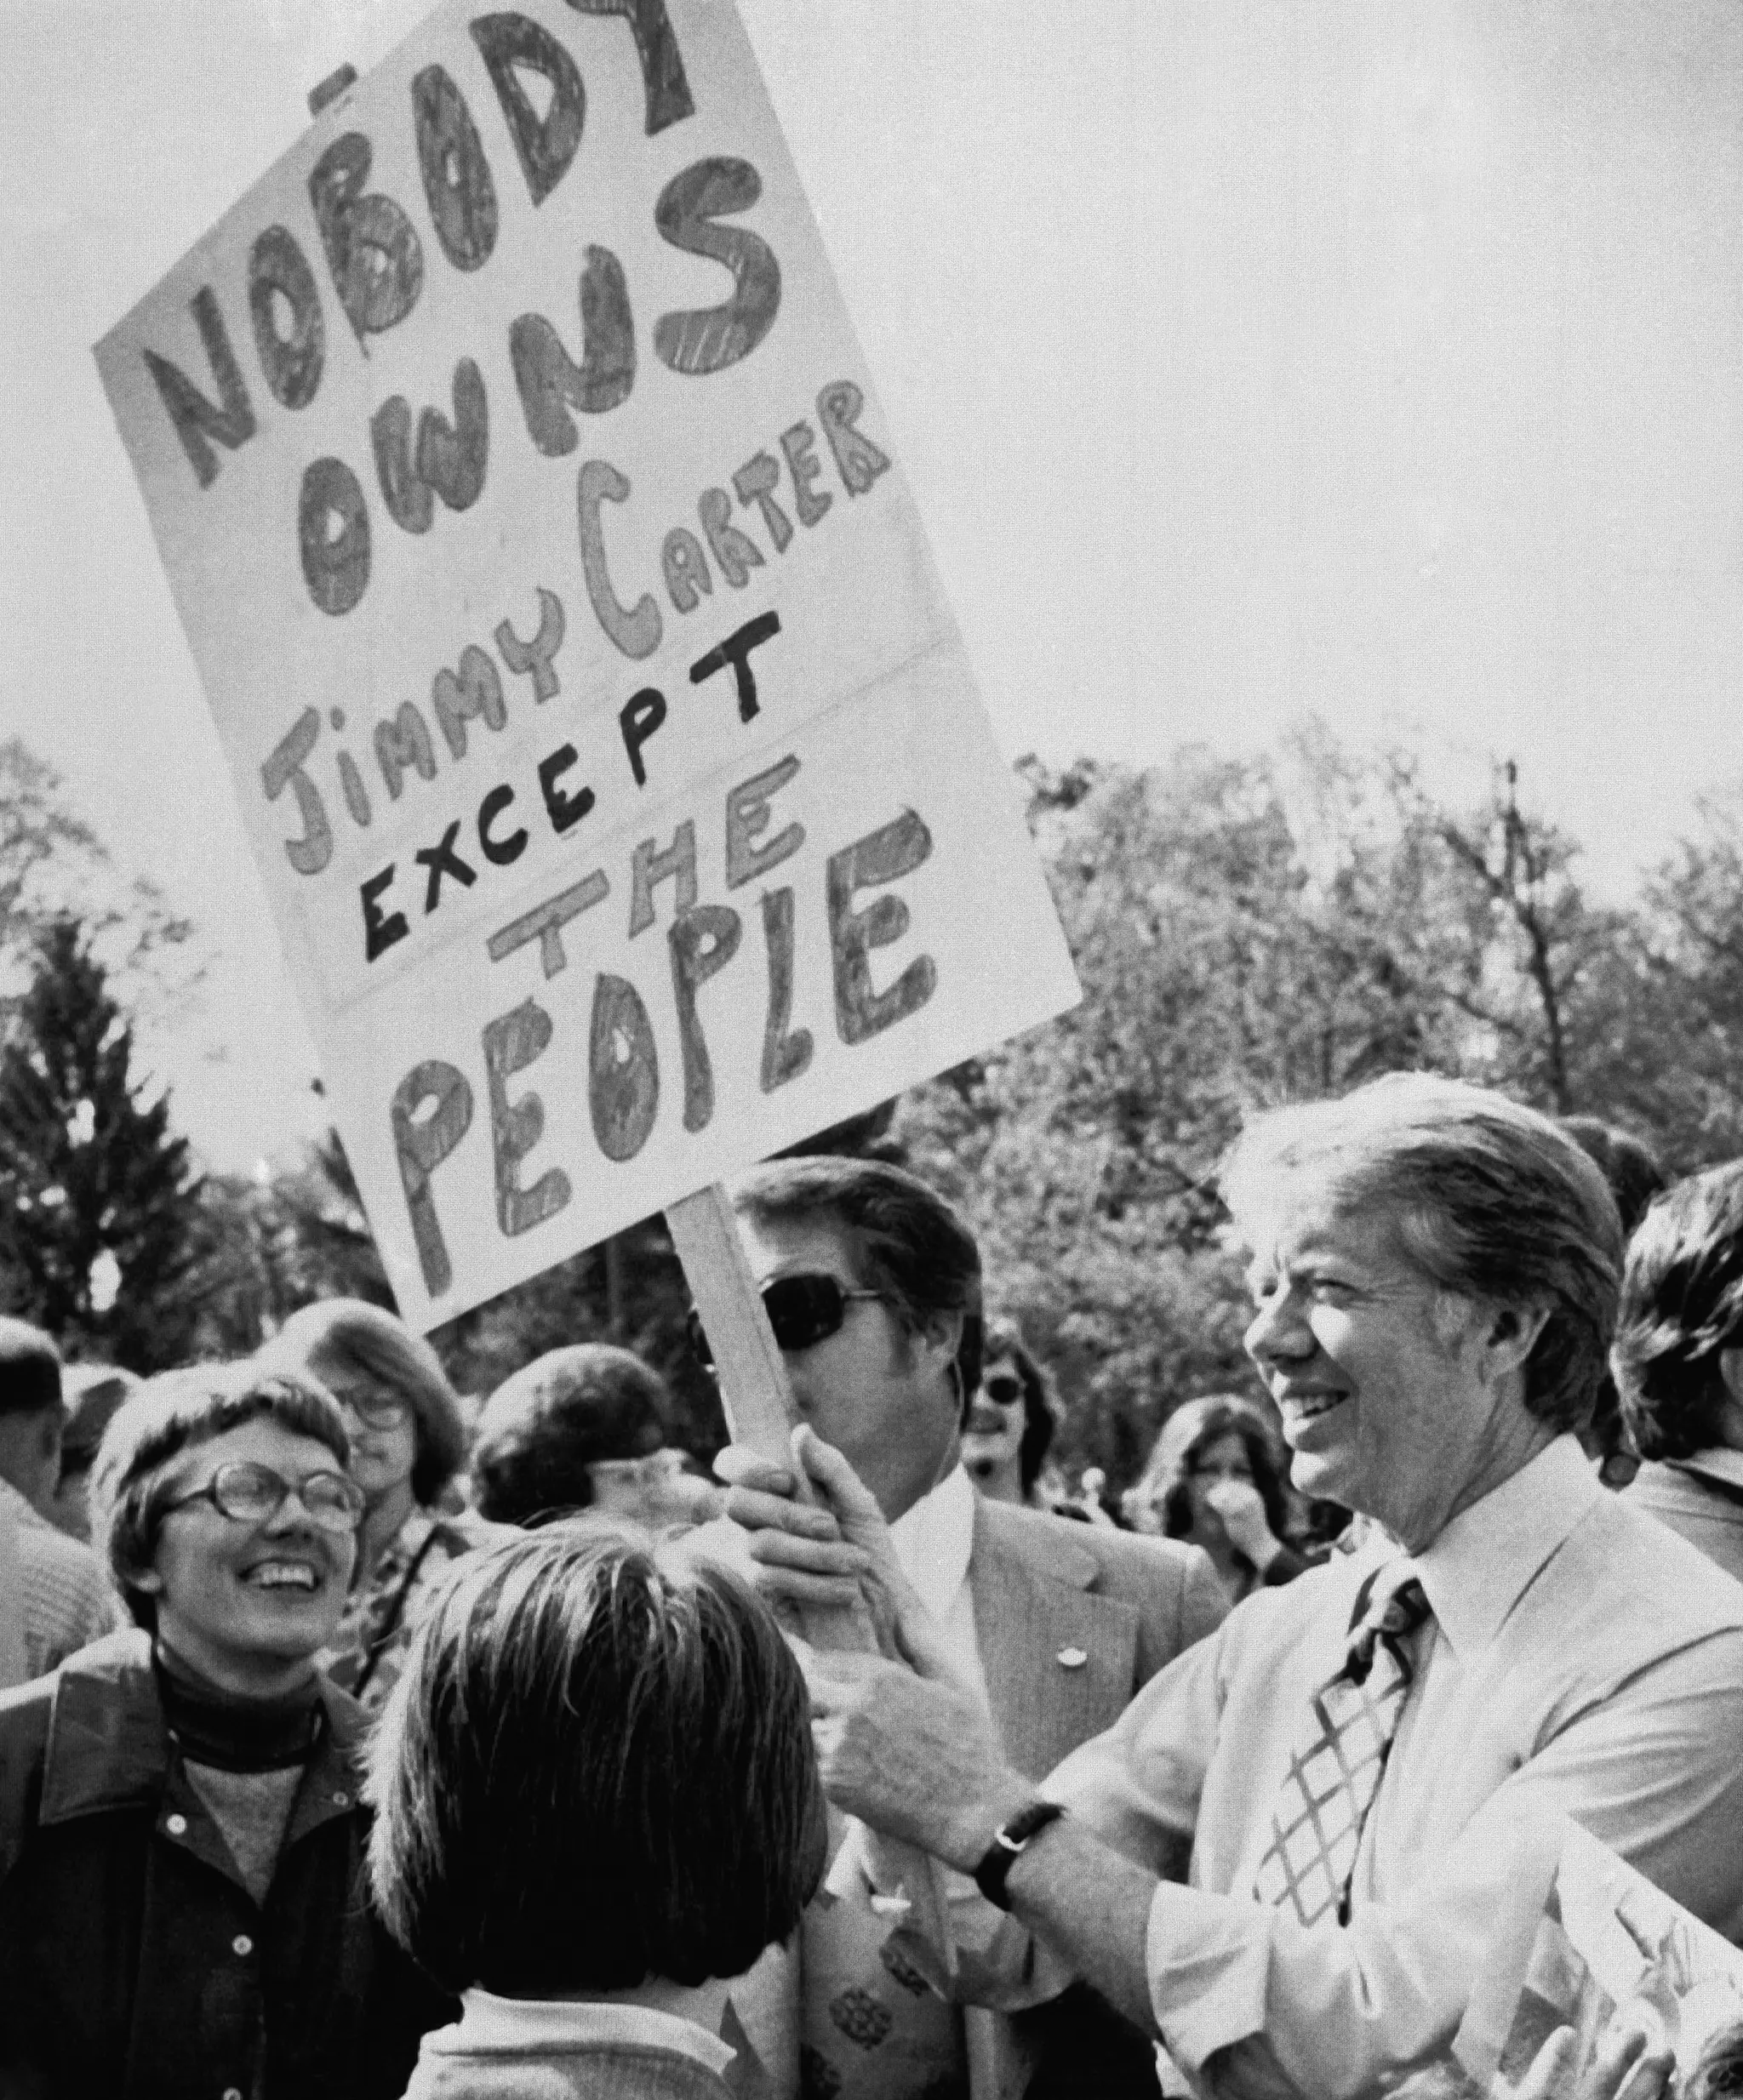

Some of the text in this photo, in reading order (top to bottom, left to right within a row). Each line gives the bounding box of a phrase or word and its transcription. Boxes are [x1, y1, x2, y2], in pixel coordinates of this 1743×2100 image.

[142, 0, 695, 491] NOBODY
[298, 156, 782, 616] OWNS
[577, 380, 891, 660] CARTER
[360, 611, 780, 962] EXCEPT
[487, 753, 806, 979] THE
[391, 805, 937, 1298] PEOPLE
